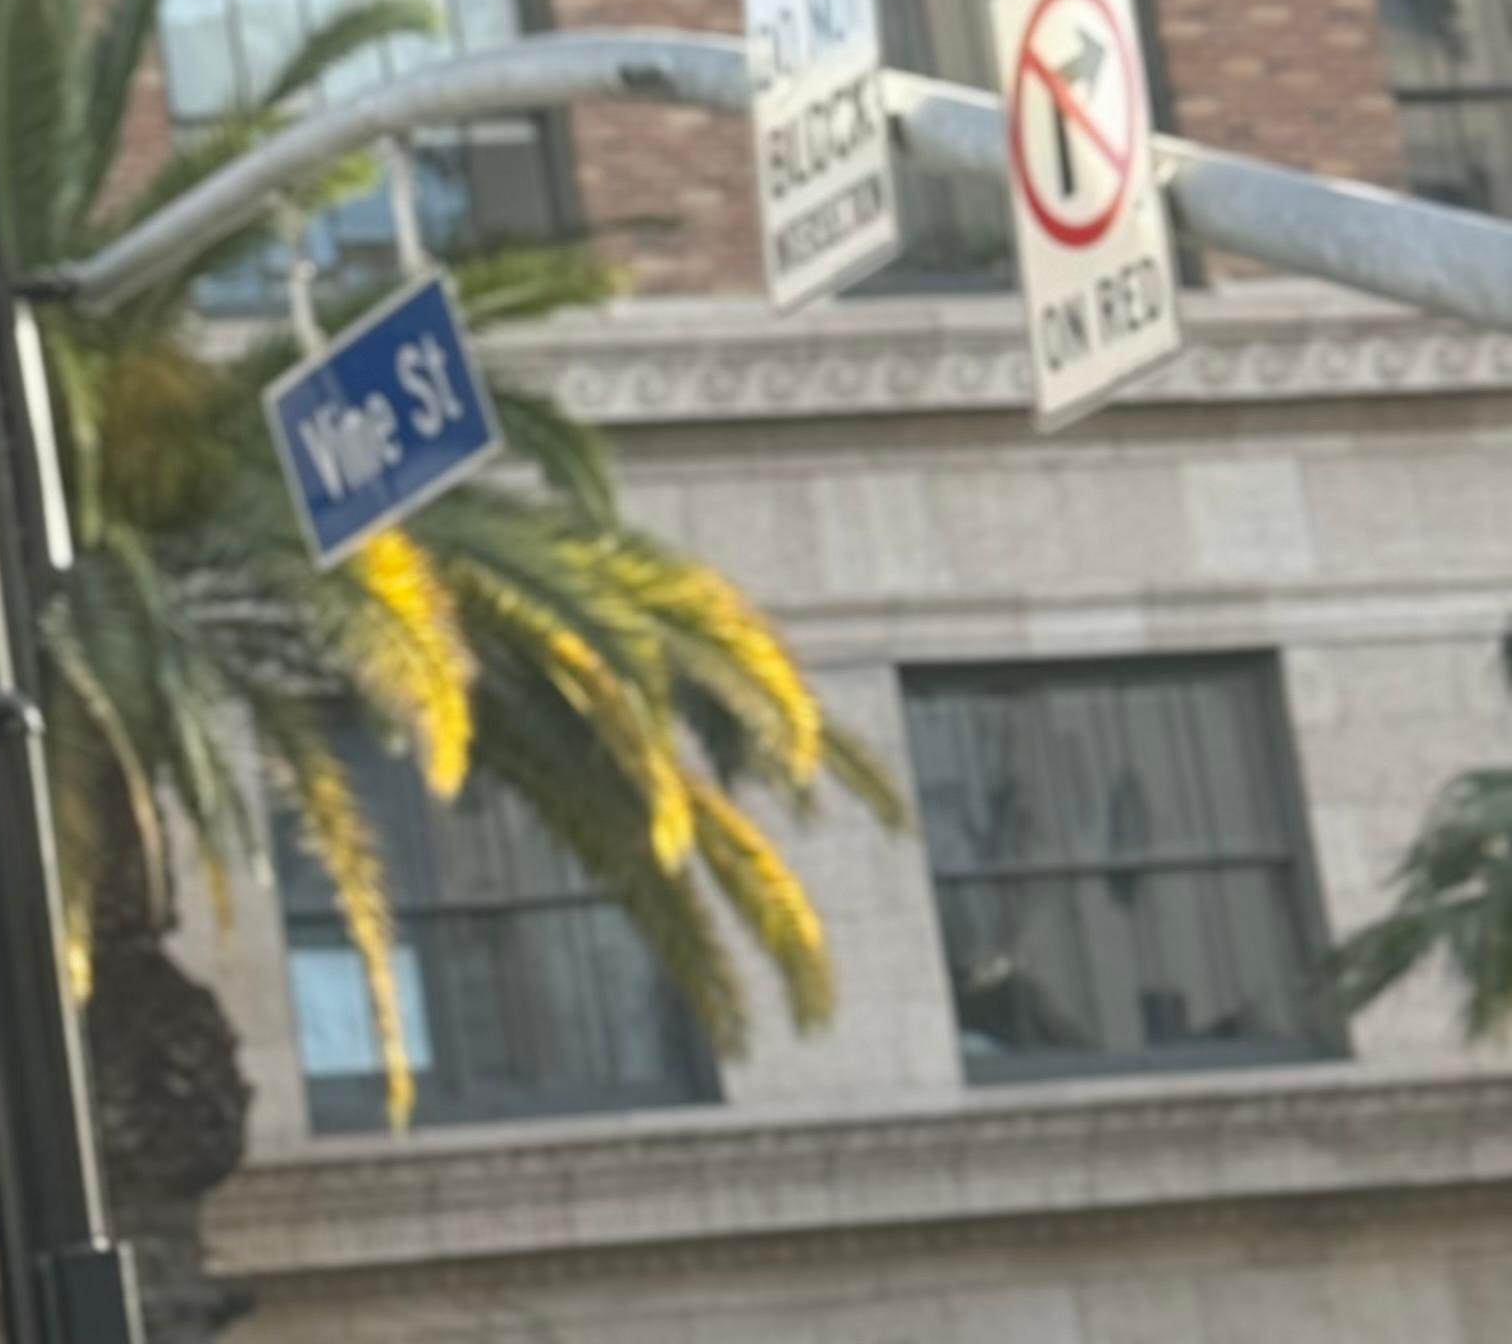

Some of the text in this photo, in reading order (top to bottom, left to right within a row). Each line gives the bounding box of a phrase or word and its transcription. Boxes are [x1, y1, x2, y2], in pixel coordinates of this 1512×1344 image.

[767, 72, 876, 199] BLOCK
[1041, 256, 1166, 372] ON RED
[298, 331, 463, 500] Vine St
